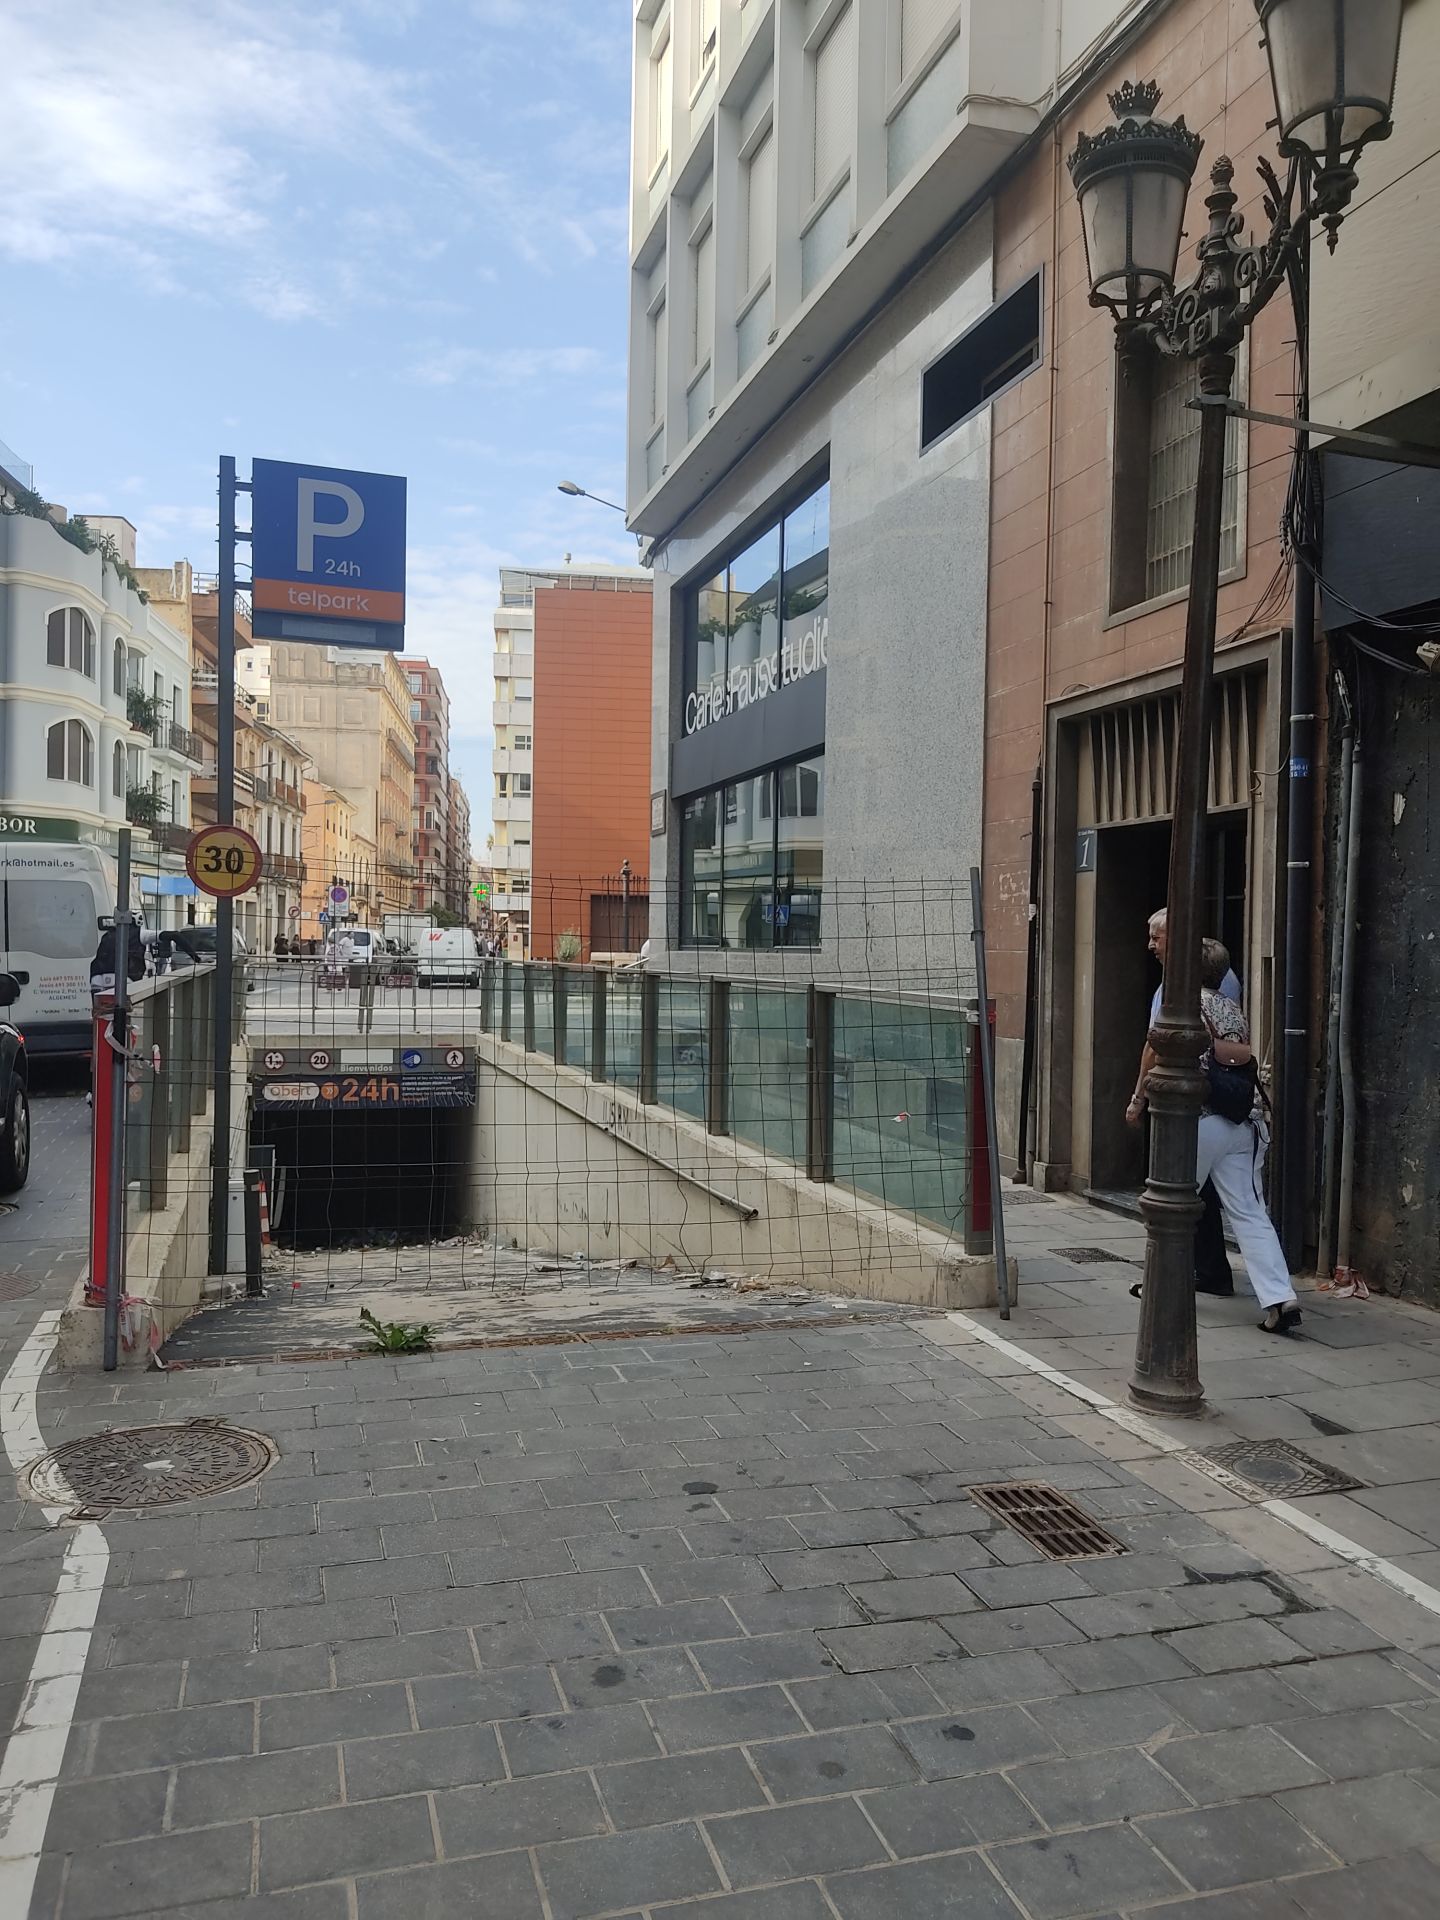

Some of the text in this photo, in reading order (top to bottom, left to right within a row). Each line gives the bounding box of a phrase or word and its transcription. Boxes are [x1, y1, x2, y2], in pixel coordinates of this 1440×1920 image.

[296, 477, 365, 573] P
[325, 558, 361, 578] 24h
[288, 587, 369, 612] telpark
[203, 845, 244, 875] 30
[1079, 837, 1090, 868] 1
[313, 1055, 326, 1065] 20
[340, 1063, 393, 1072] Bienvenidos
[342, 1077, 400, 1102] 24h
